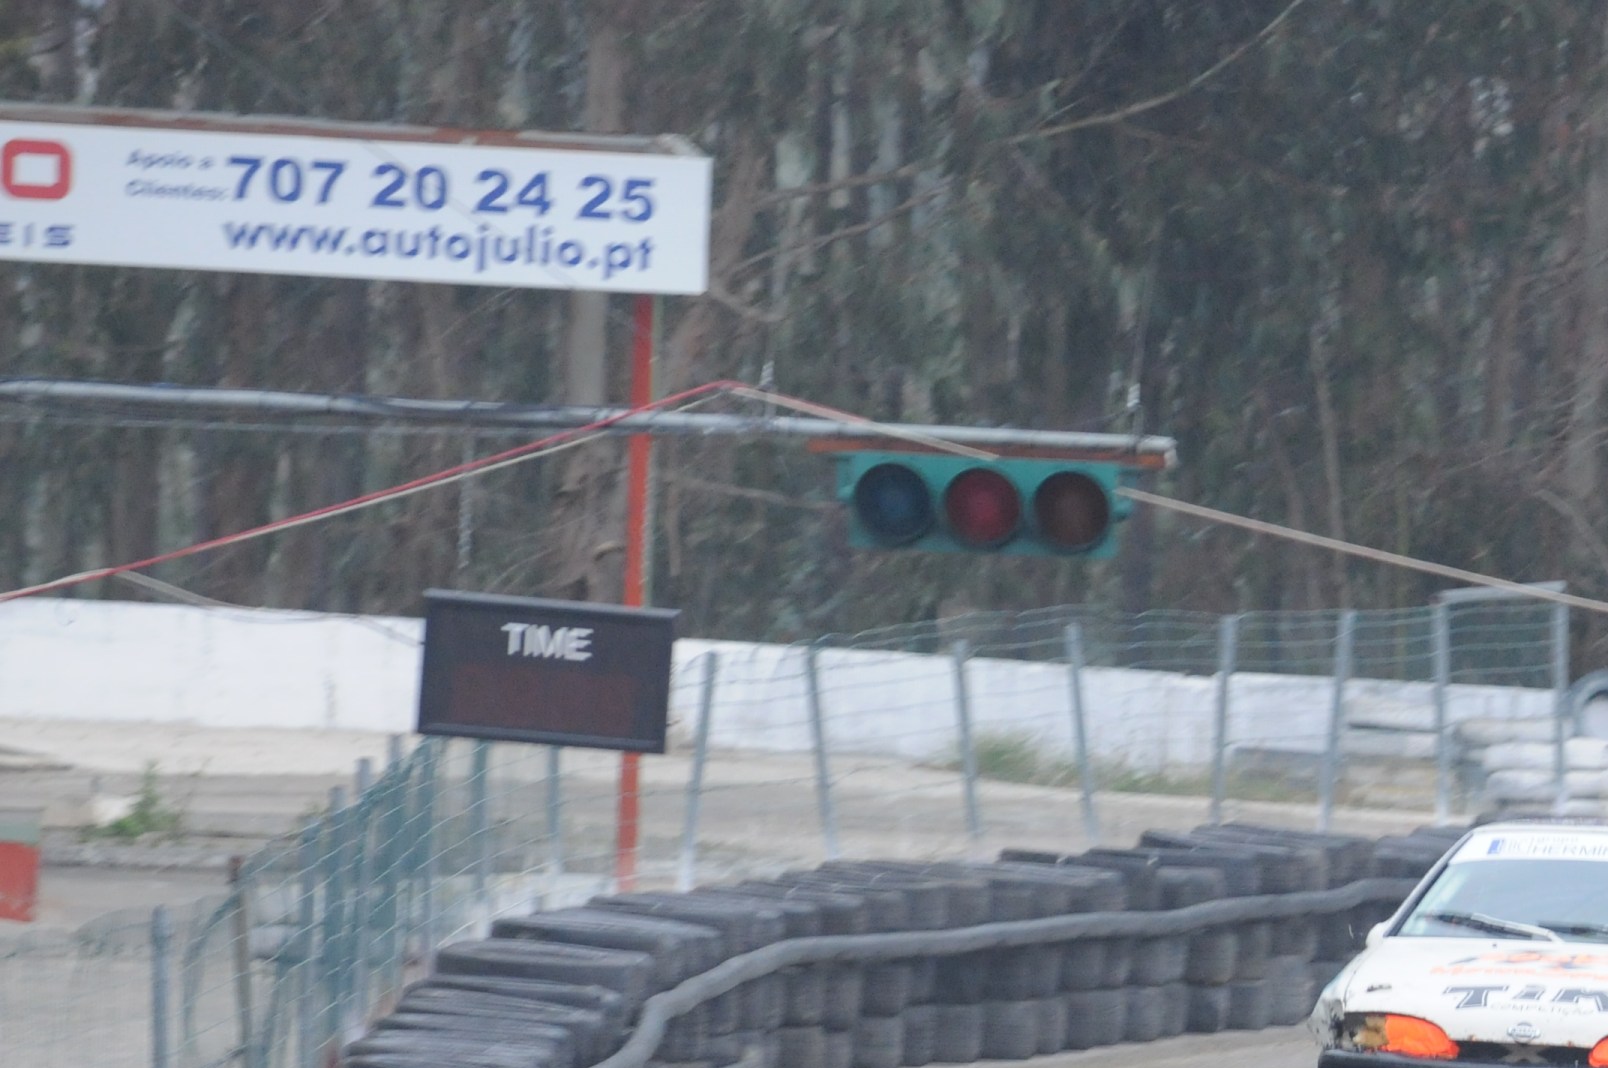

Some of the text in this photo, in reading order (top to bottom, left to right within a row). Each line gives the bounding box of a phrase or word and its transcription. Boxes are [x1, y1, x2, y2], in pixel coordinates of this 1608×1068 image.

[227, 156, 657, 222] 707 20 24 25
[222, 220, 656, 280] www.autojulio.pt
[501, 621, 595, 661] TIME
